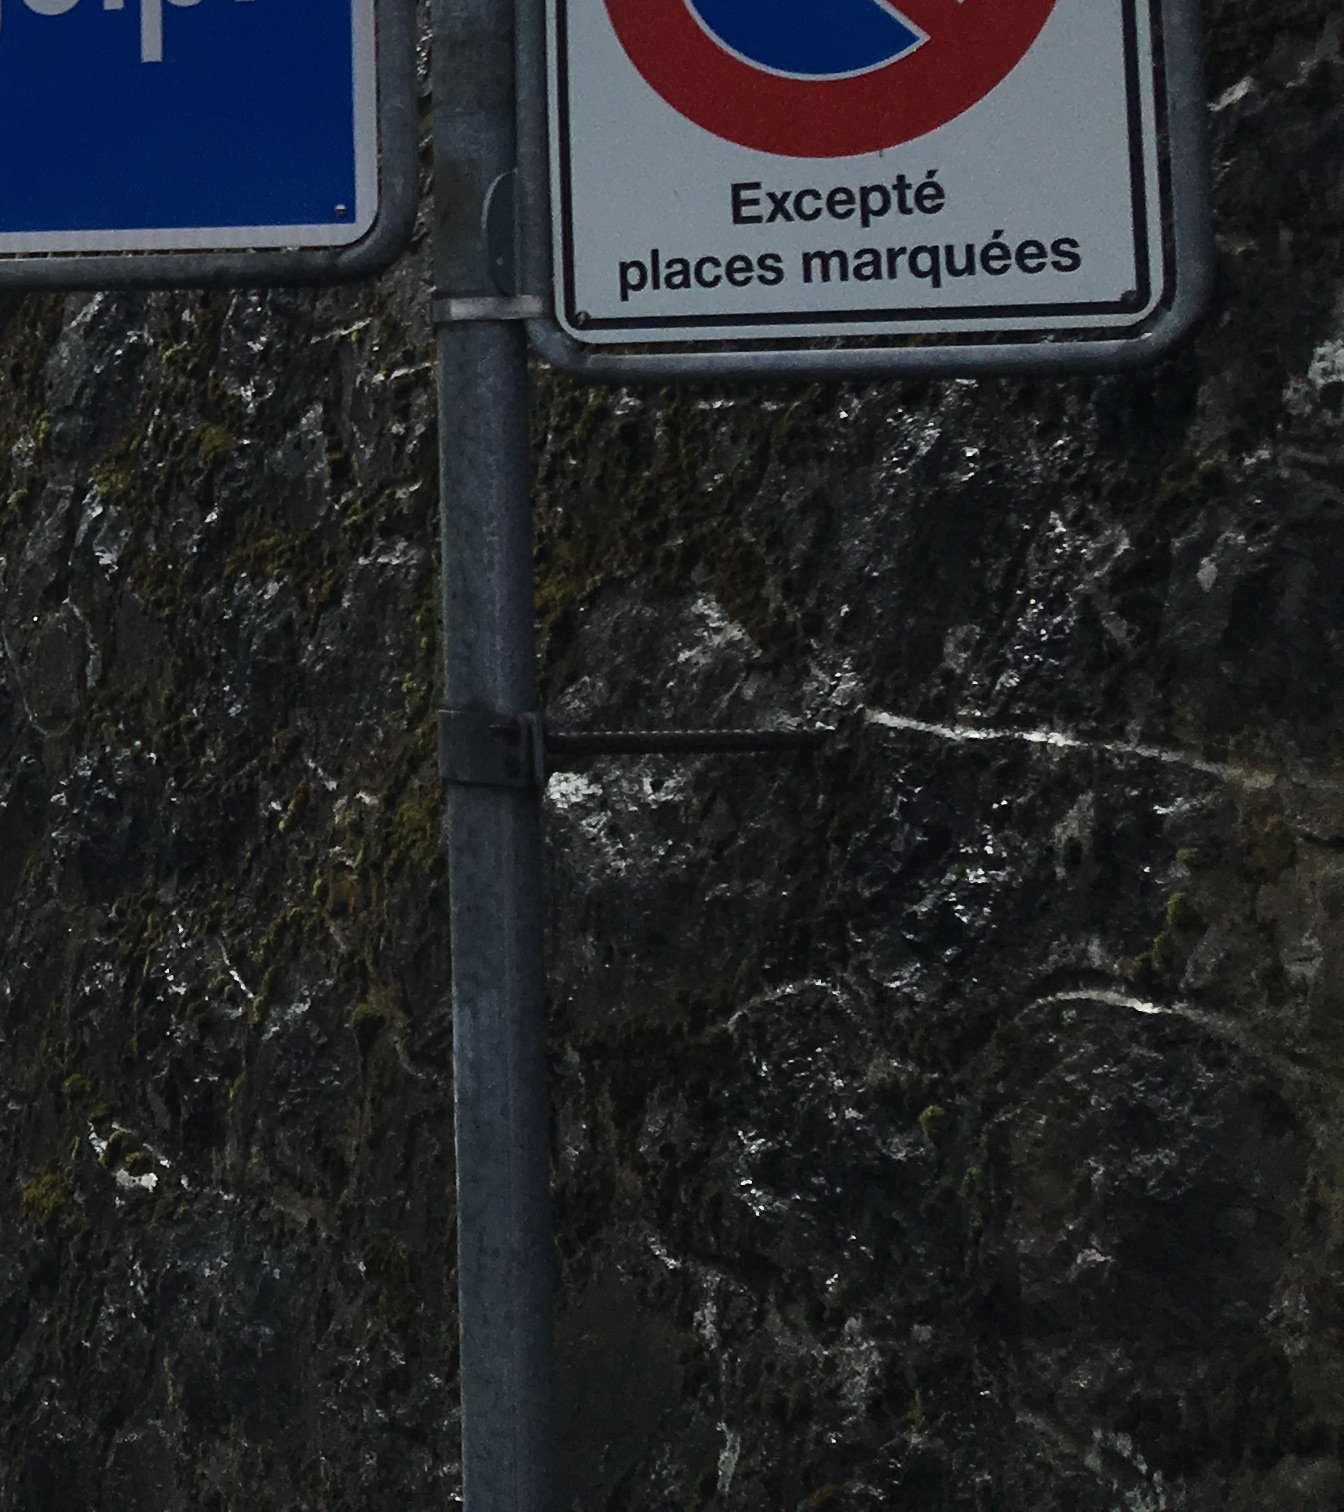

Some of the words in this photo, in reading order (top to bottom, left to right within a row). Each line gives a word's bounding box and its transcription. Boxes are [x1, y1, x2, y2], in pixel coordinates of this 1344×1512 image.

[730, 168, 946, 228] Excepté
[617, 247, 785, 302] places
[801, 228, 1082, 289] marquées
